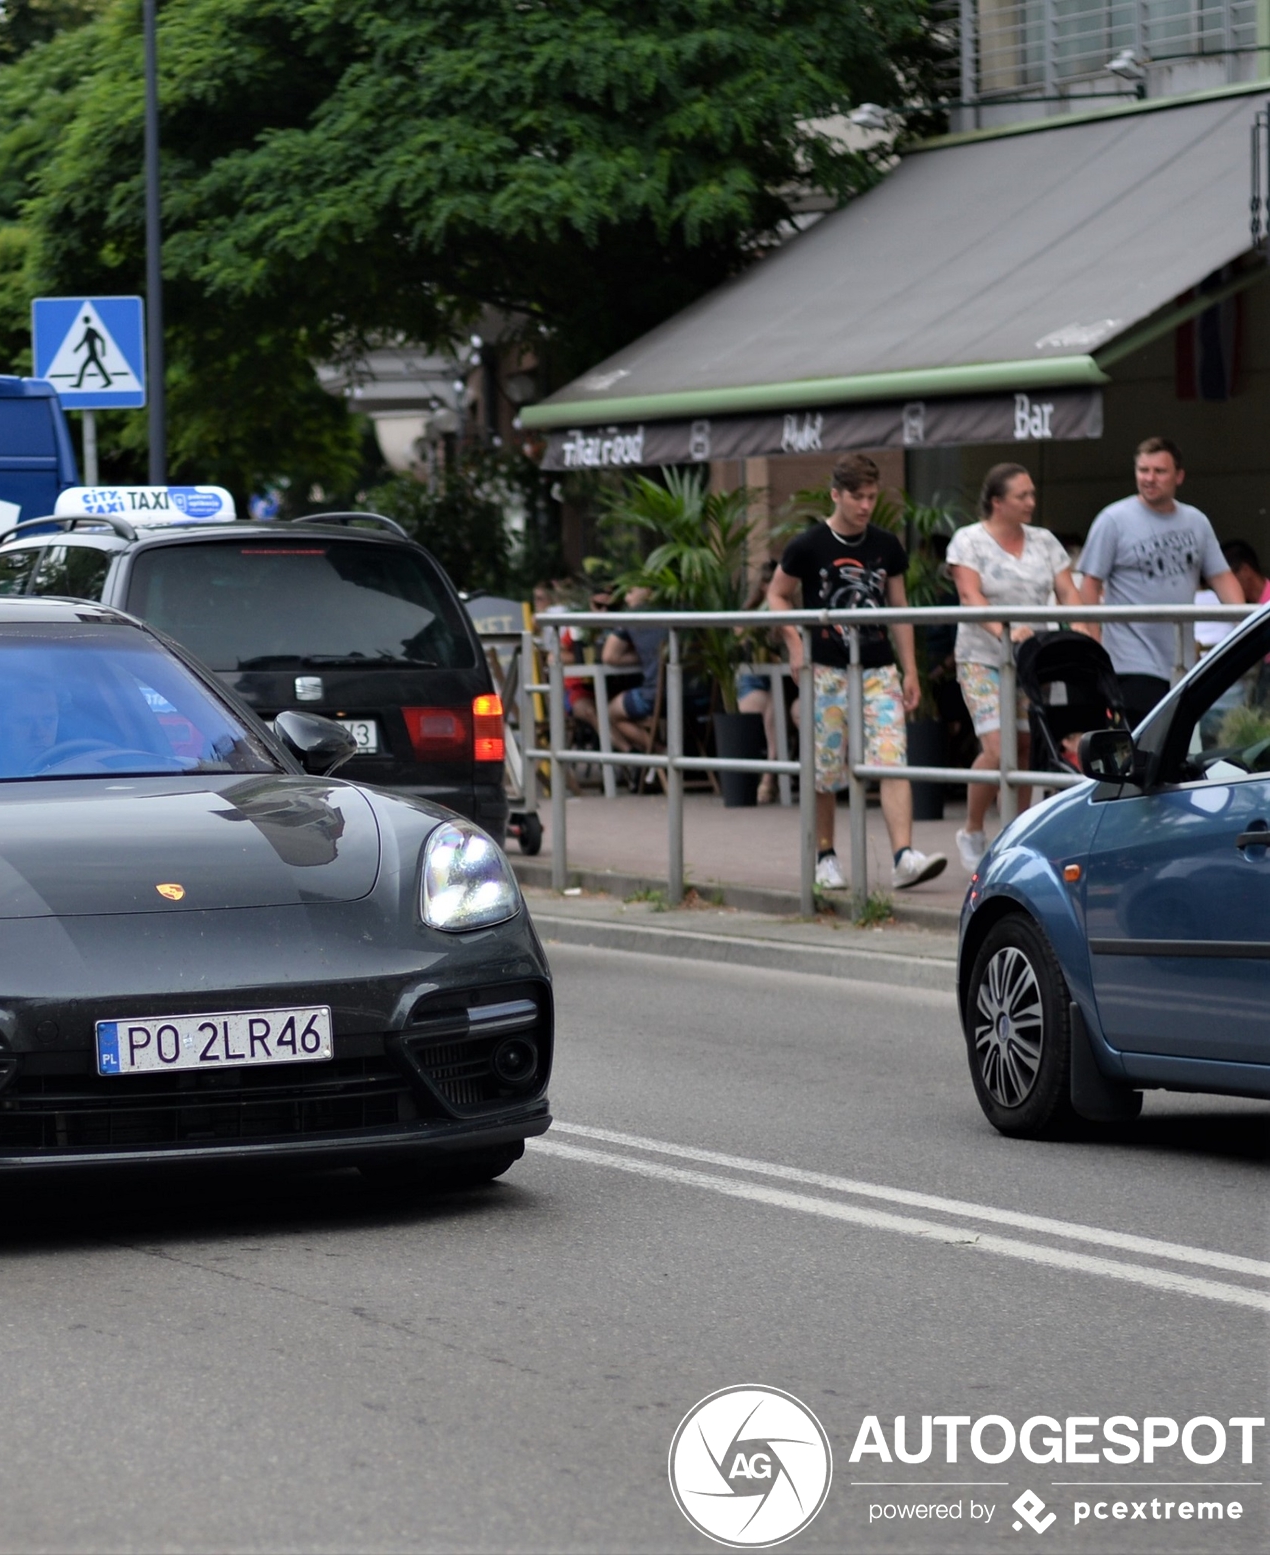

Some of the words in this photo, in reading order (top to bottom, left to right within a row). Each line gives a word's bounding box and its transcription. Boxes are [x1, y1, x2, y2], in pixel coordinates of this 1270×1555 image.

[1014, 393, 1054, 439] Bar
[127, 491, 170, 510] TAXI
[473, 615, 513, 633] KET
[128, 1024, 180, 1066] PO
[197, 1014, 321, 1061] 2LR46
[102, 1054, 118, 1065] PL
